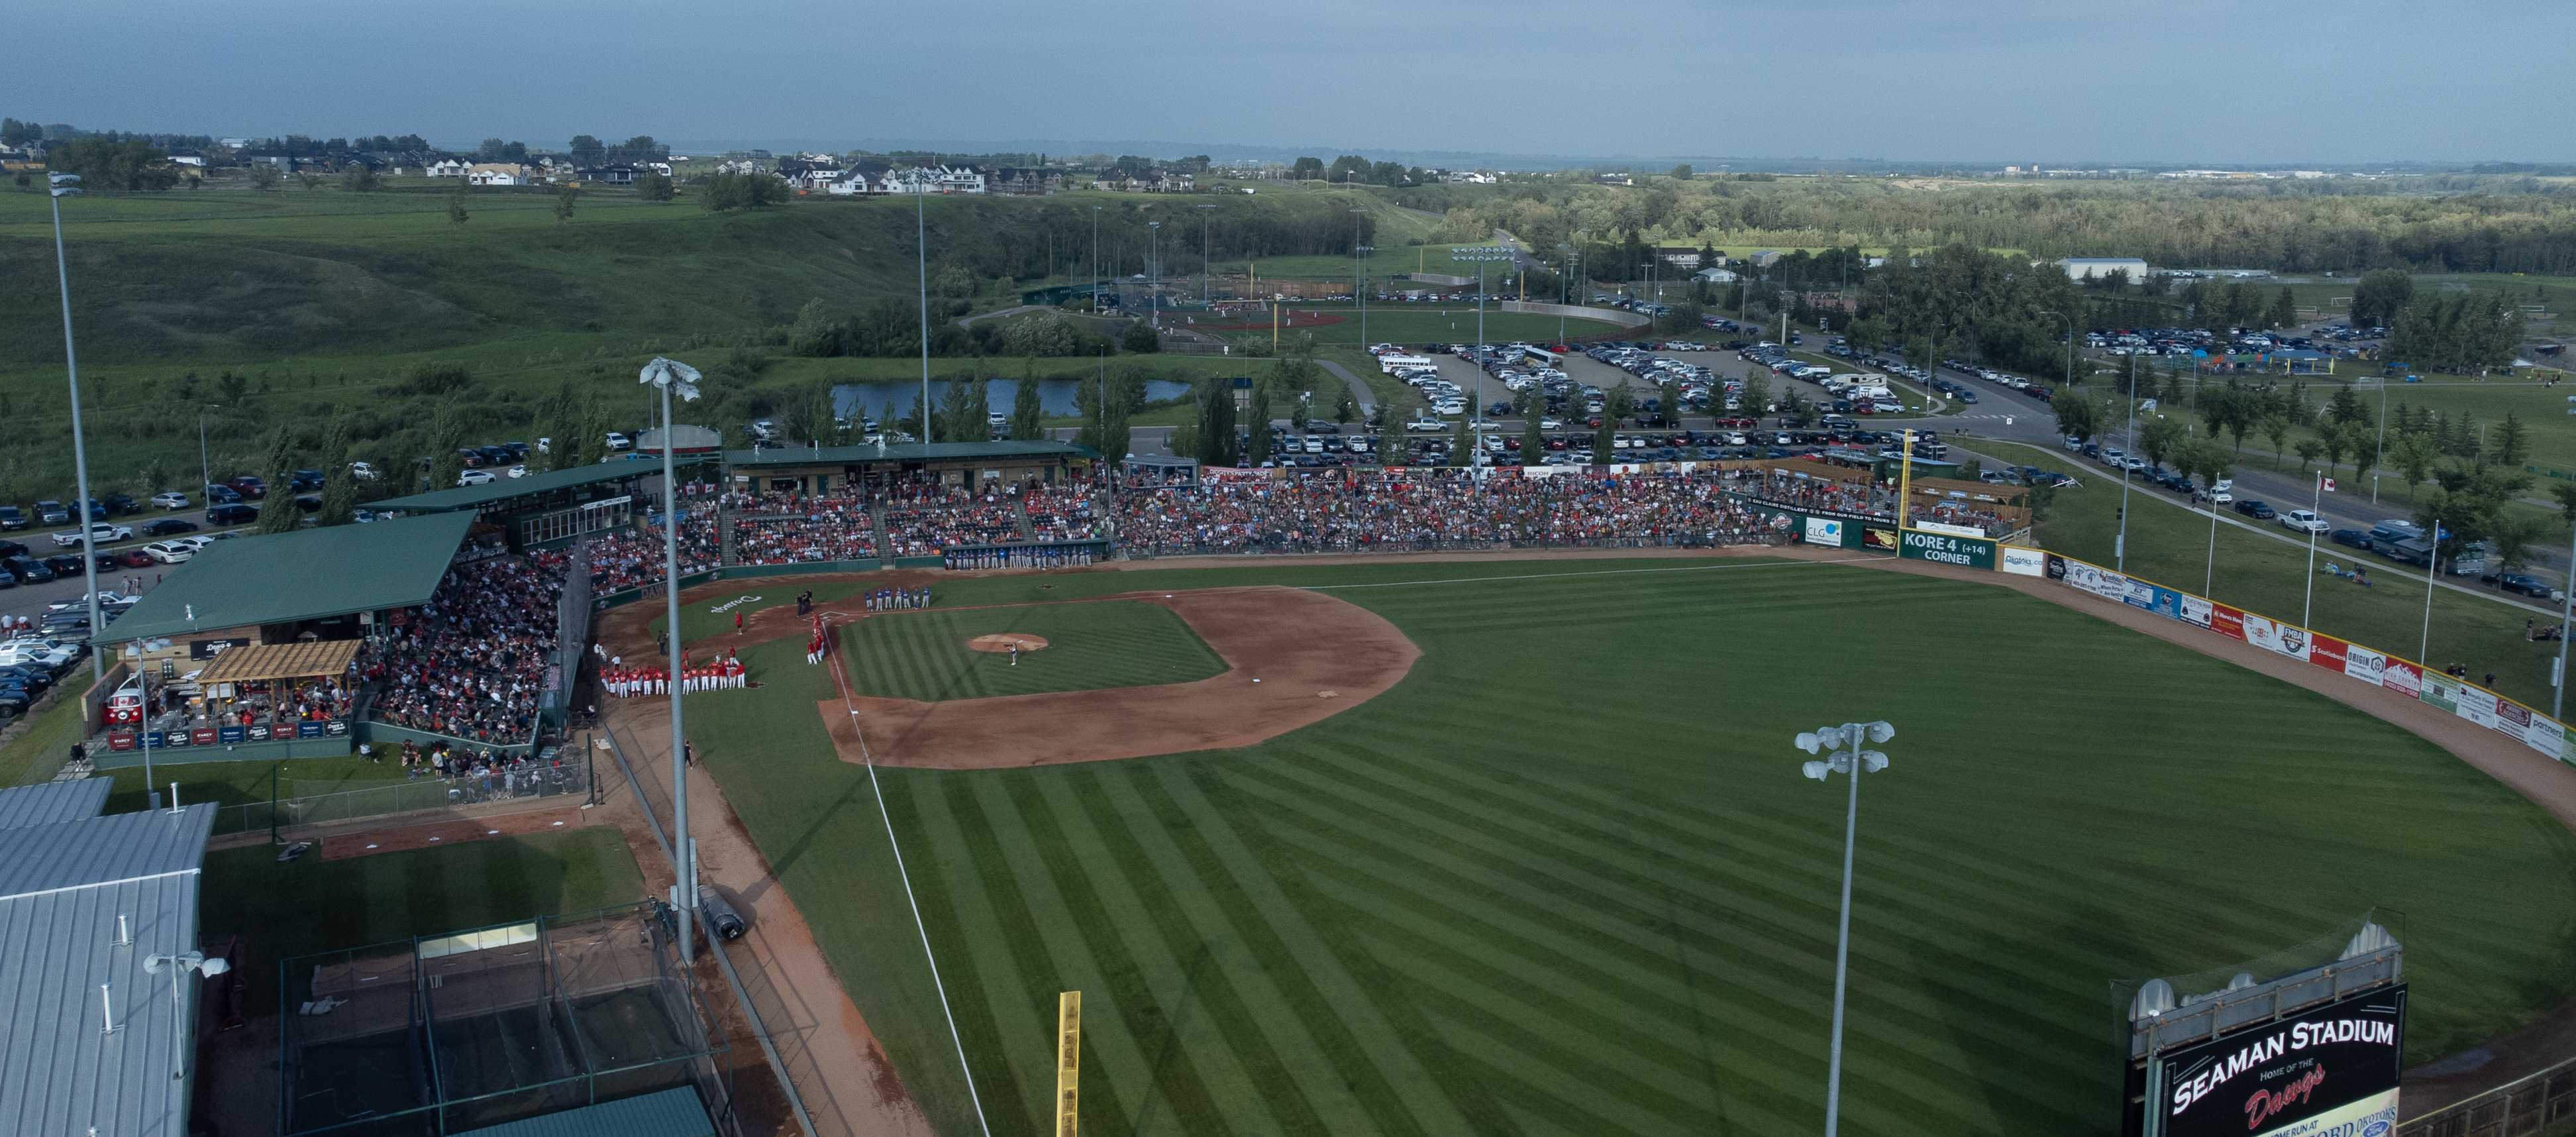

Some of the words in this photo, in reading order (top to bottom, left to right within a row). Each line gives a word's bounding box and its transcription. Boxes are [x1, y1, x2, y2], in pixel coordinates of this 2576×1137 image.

[1780, 504, 1808, 513] DISTILLERY
[1806, 527, 1825, 537] CLG
[1905, 533, 1945, 550] KORE
[1947, 539, 1957, 551] 4
[1962, 544, 1986, 555] (+14)
[1924, 550, 1971, 565] CORNER
[2285, 627, 2304, 641] FMBA
[2317, 647, 2346, 661] Scotiabank
[2348, 651, 2370, 667] ORIGIN
[2533, 719, 2563, 739] partners
[2173, 1032, 2285, 1116] SEAMAN
[2291, 1020, 2395, 1050] STADIUM
[2259, 1070, 2285, 1082] HOME
[2286, 1063, 2296, 1073] OF
[2297, 1058, 2314, 1067] THE
[2244, 1062, 2326, 1130] Dawgs
[2357, 1107, 2396, 1132] OKOTOKS
[2291, 1124, 2308, 1137] RUN
[2308, 1120, 2318, 1132] AT
